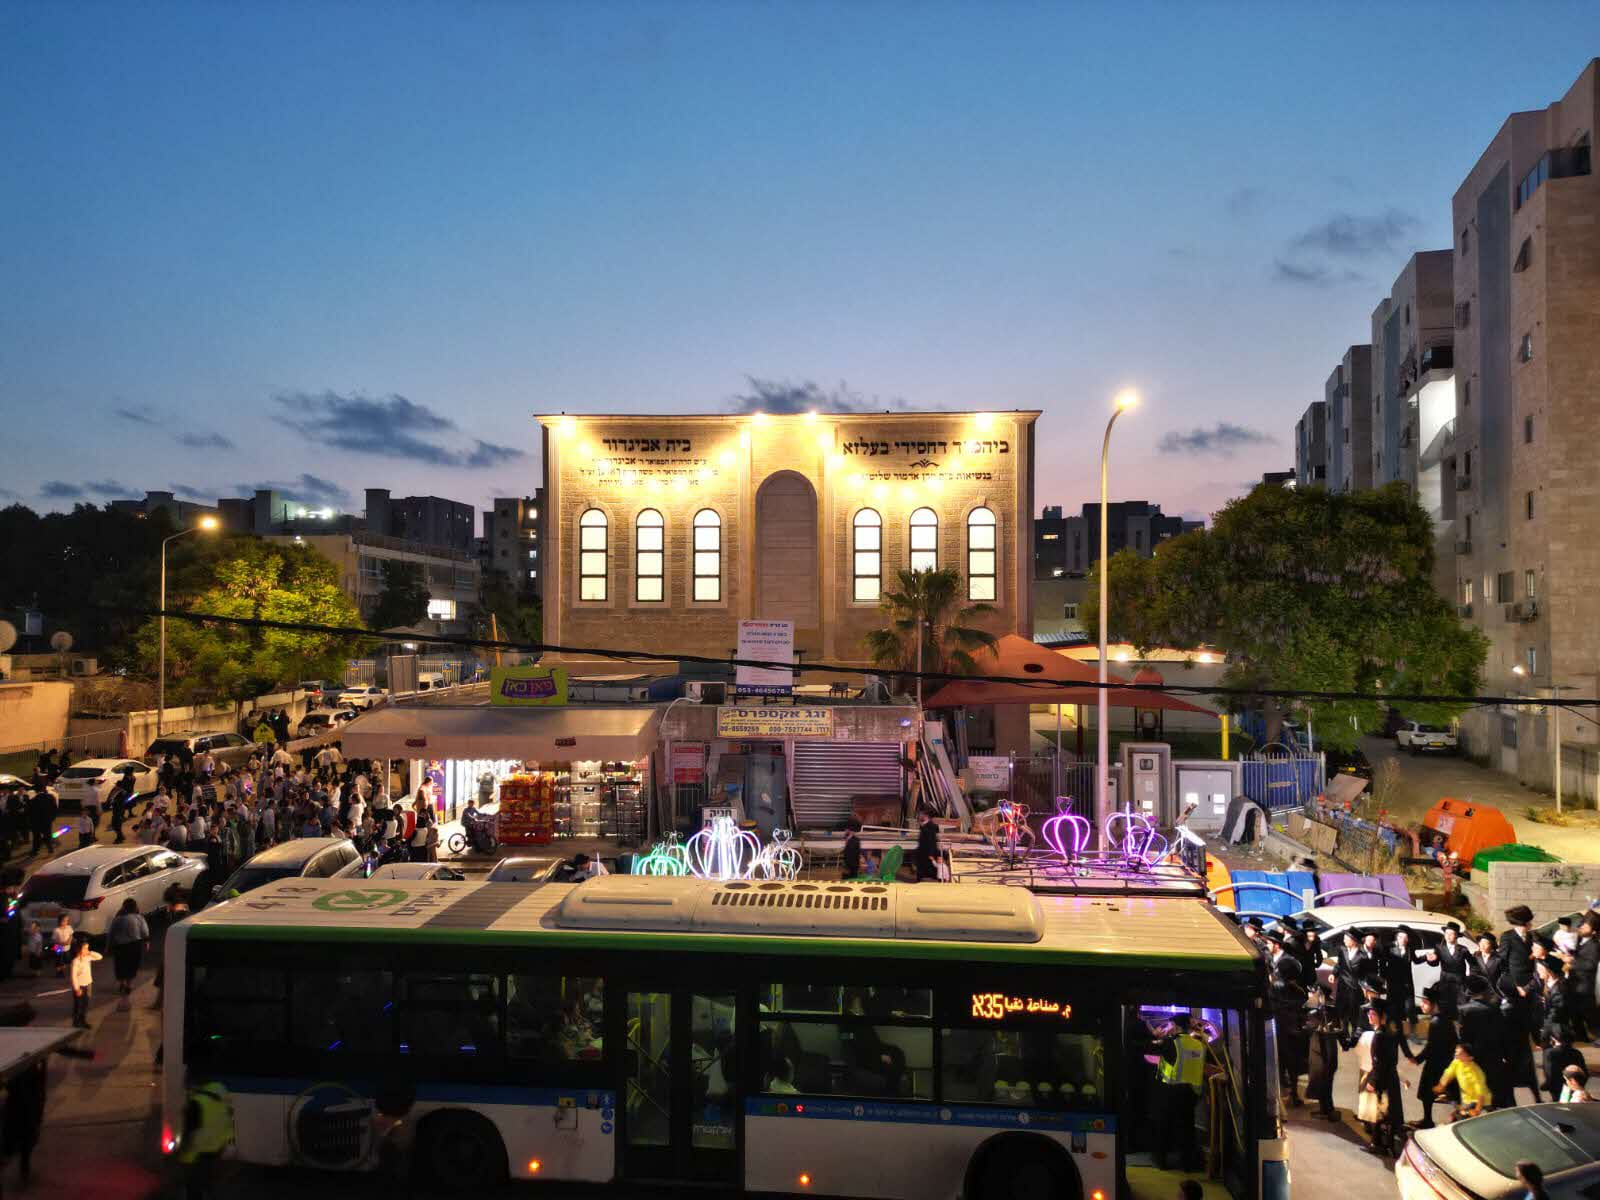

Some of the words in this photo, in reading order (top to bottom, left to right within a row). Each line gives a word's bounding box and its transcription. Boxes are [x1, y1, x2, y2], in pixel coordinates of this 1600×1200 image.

[665, 439, 691, 452] בית
[842, 436, 889, 456] בעלזא
[895, 441, 947, 454] דחסידי
[738, 710, 800, 719] אקספרס
